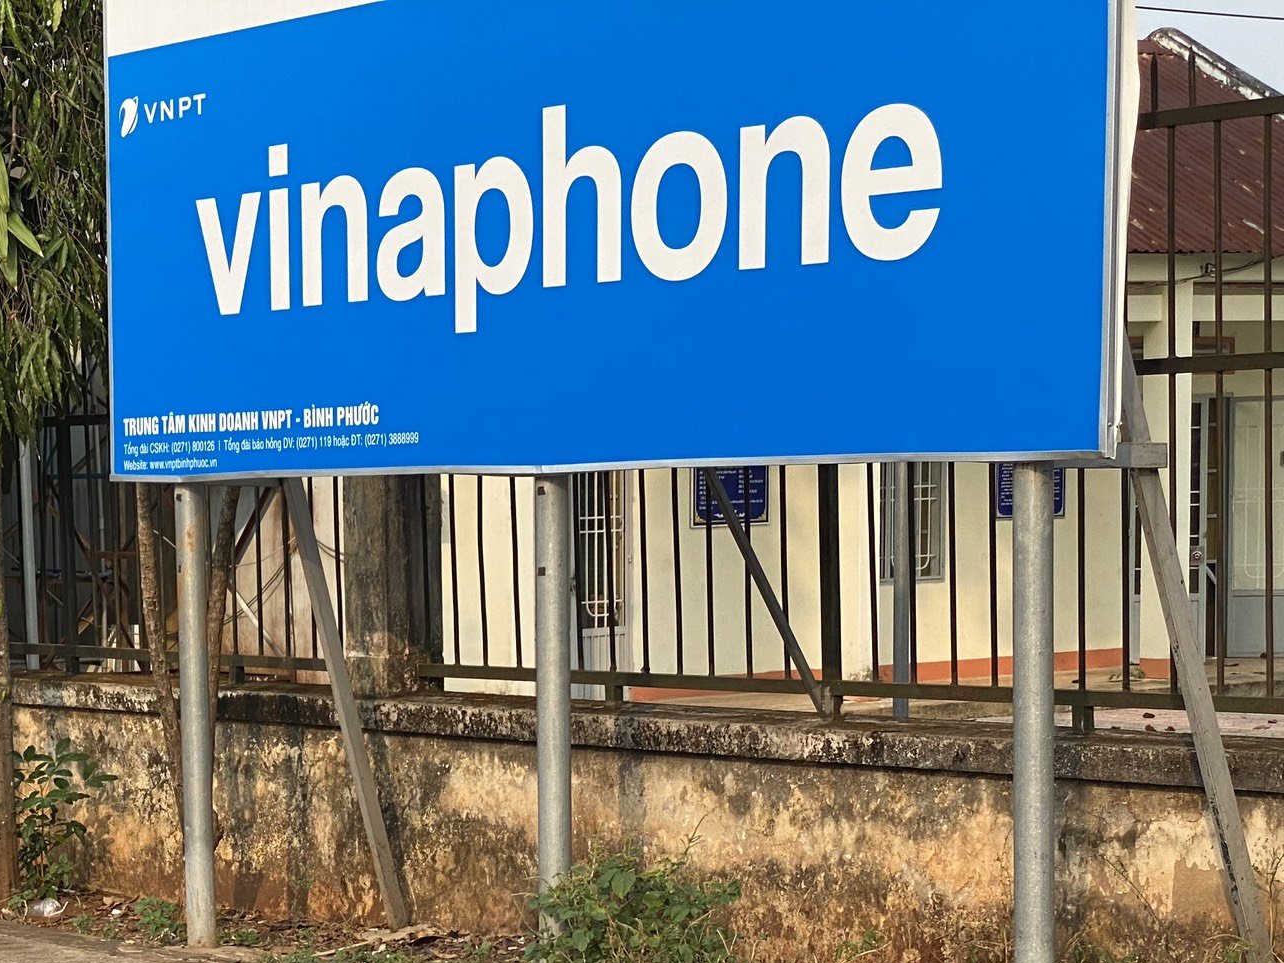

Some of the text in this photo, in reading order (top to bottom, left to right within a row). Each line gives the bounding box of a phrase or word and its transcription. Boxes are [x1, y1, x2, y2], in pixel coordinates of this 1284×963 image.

[143, 93, 207, 124] VNPT
[196, 103, 943, 333] vinaphone
[123, 416, 159, 436] TRUNG
[161, 412, 186, 434] TÂM
[188, 413, 217, 433] KINH
[219, 411, 259, 432] DOANH
[261, 409, 293, 430] VNPT
[303, 404, 334, 428] BÌNH
[336, 401, 380, 427] PHƯỚC
[123, 441, 139, 457] Tổng
[139, 441, 149, 454] đài
[149, 441, 170, 453] CSKH:
[171, 441, 191, 455] (0271)
[192, 440, 216, 452] 800126
[224, 437, 240, 453] Tổng
[240, 438, 251, 451] đài
[252, 438, 264, 450] báo
[265, 436, 282, 452] hỏng
[283, 437, 295, 449] DV:
[296, 436, 318, 450] (0271)
[320, 435, 332, 447] 119
[333, 435, 350, 449] hoặc
[351, 433, 363, 446] ĐT:
[364, 433, 387, 447] (0271)
[388, 431, 420, 445] 3888999
[123, 460, 149, 471] Website:
